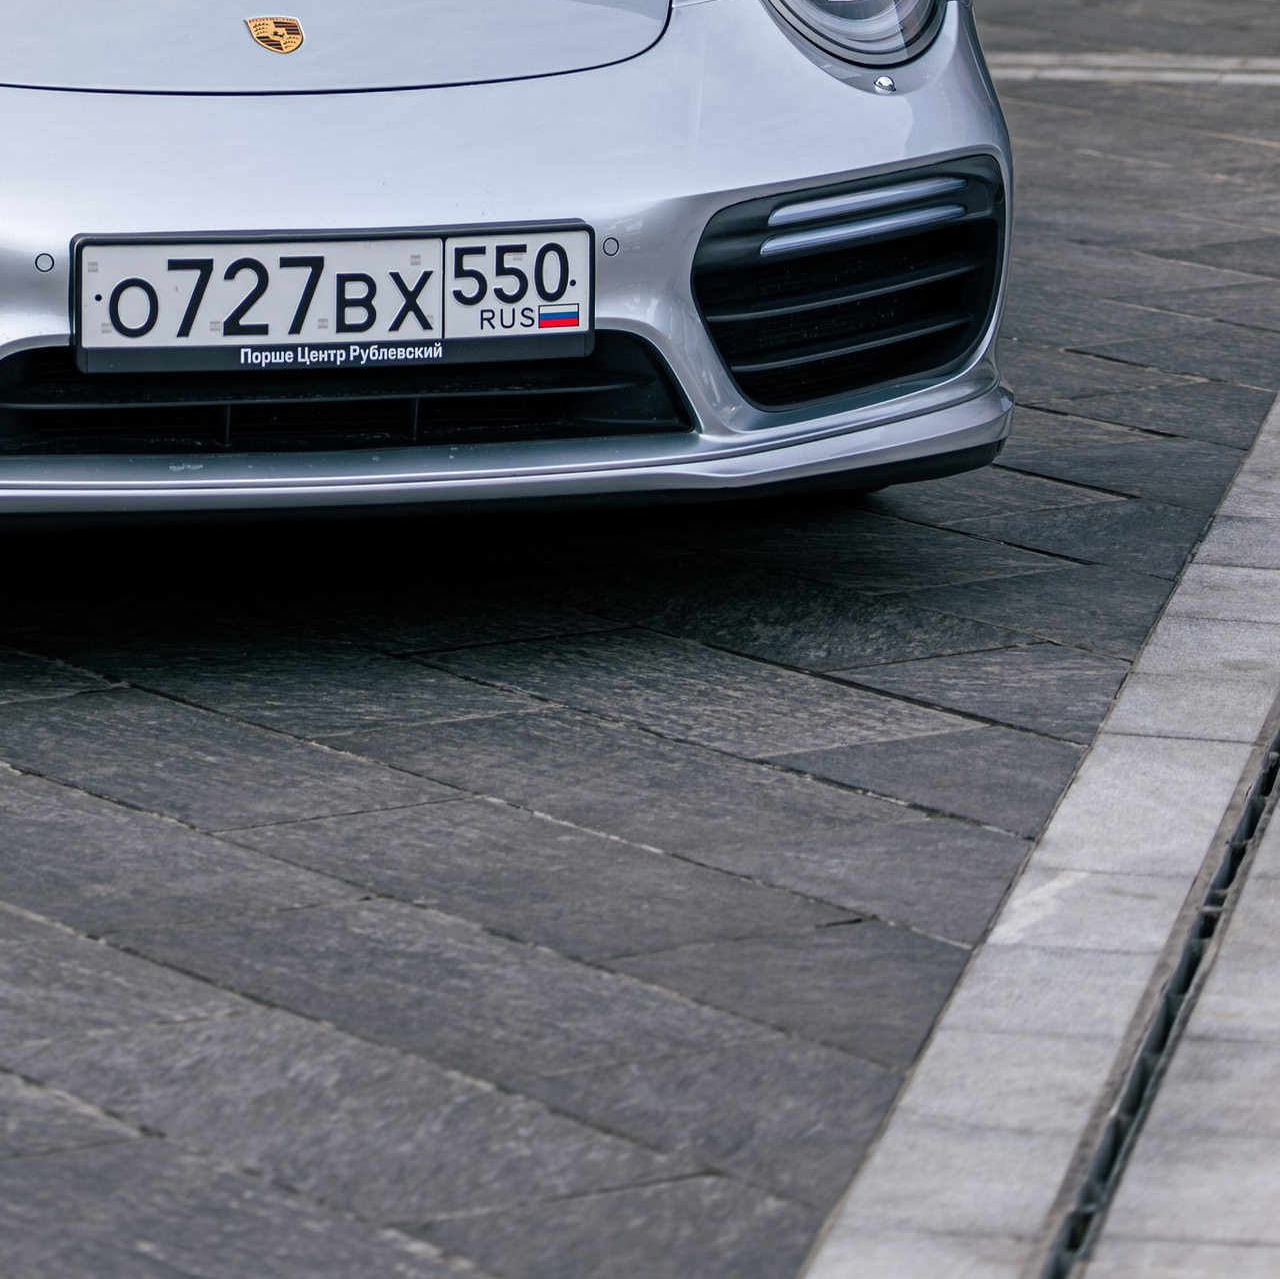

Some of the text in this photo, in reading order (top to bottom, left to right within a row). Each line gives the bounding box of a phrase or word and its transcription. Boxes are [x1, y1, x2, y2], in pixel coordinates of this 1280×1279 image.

[452, 242, 569, 306] 550
[480, 307, 535, 330] RUS
[240, 342, 443, 367] Порше Центр Рублевский
